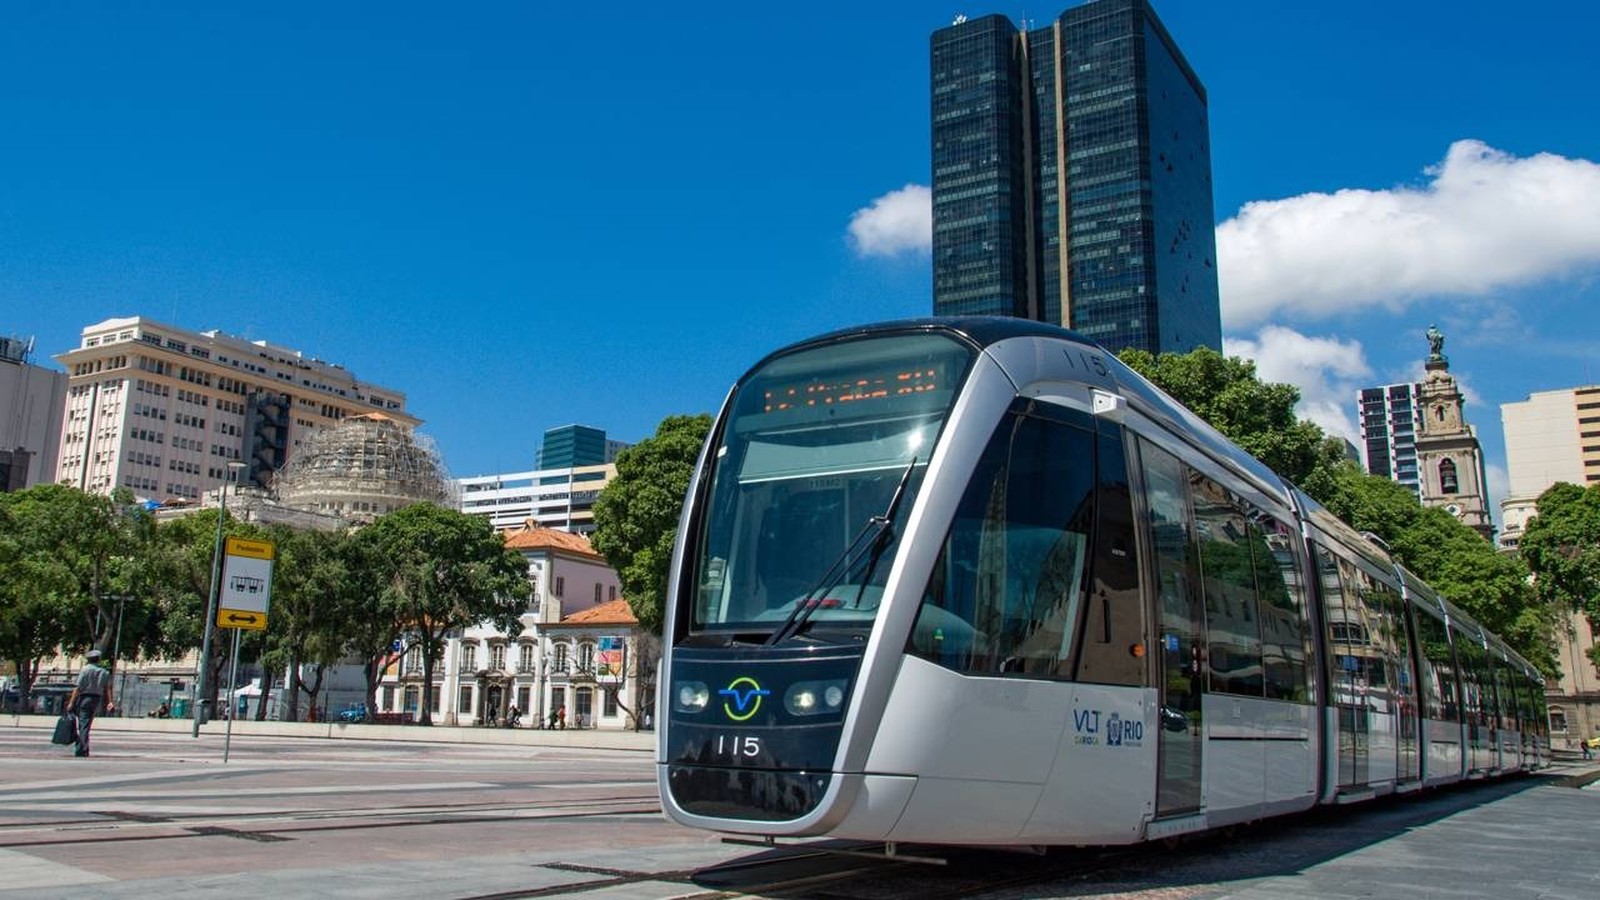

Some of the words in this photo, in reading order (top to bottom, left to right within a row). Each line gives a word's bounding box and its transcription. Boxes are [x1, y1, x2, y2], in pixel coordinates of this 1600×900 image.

[1063, 349, 1107, 377] 115
[1073, 708, 1102, 733] VLT
[1124, 720, 1143, 740] RIO
[718, 735, 760, 756] 115
